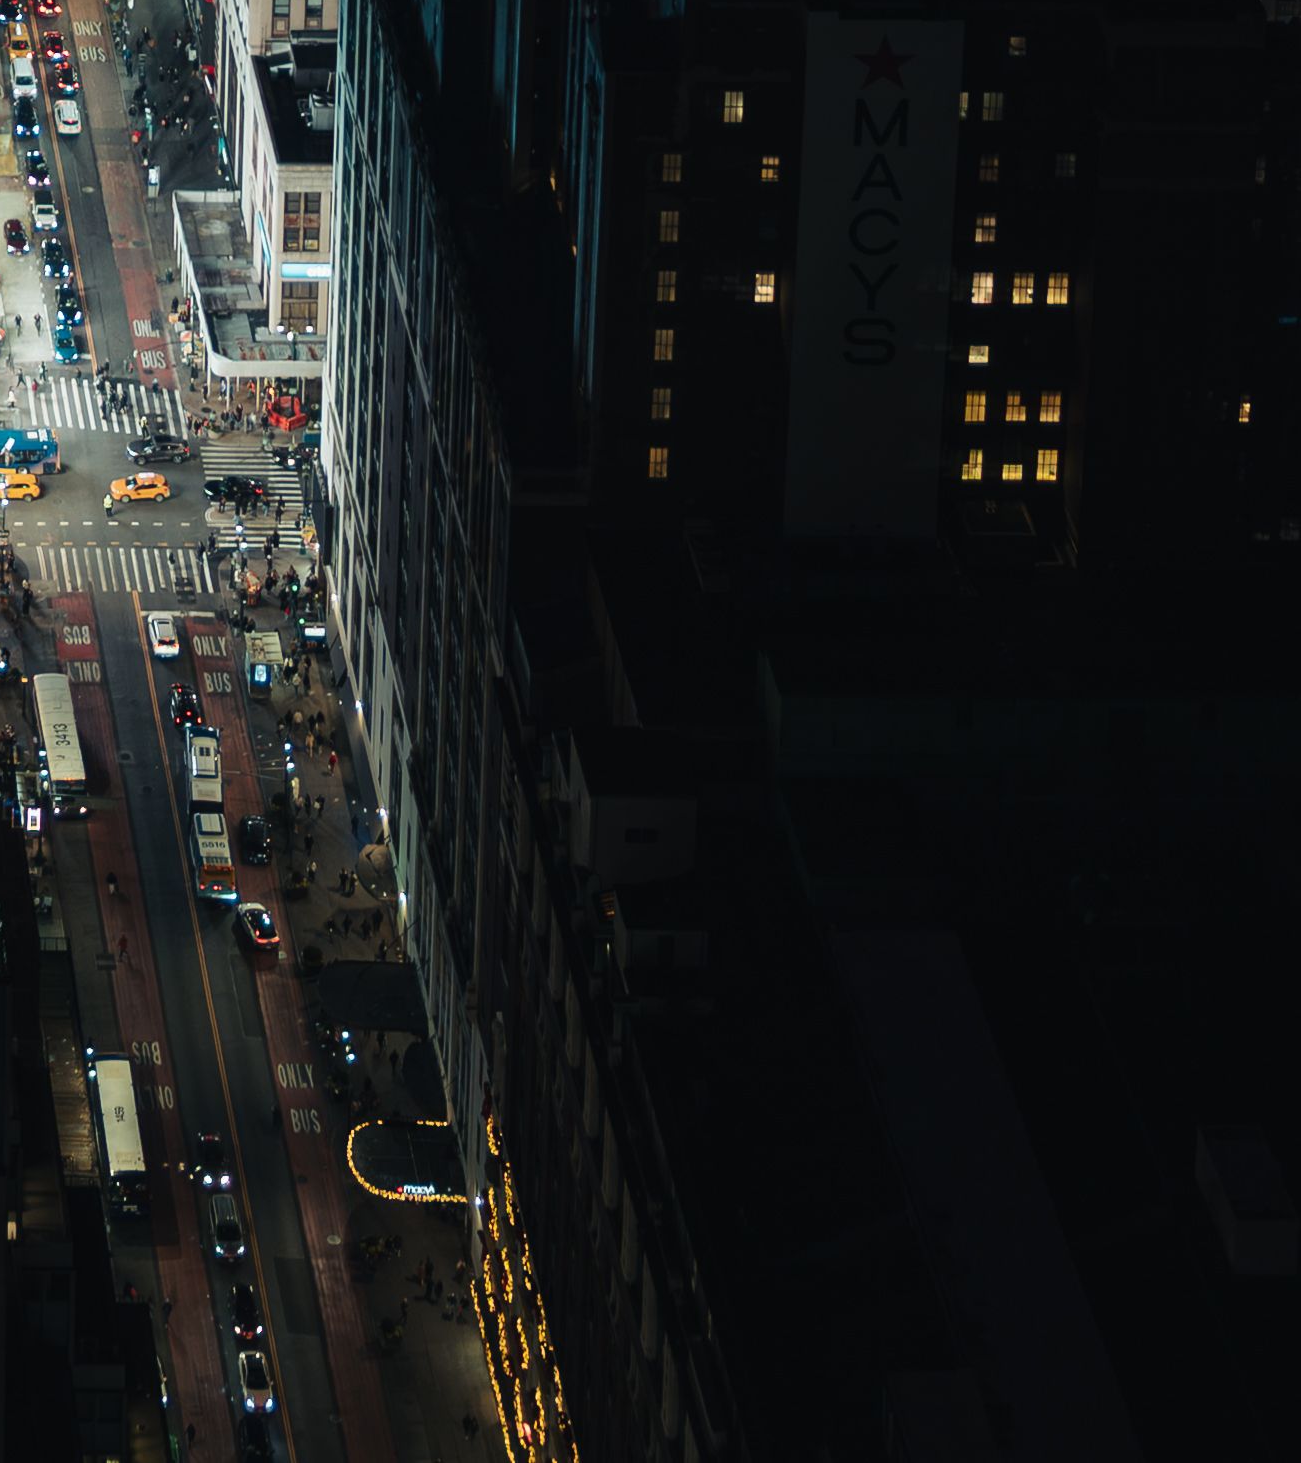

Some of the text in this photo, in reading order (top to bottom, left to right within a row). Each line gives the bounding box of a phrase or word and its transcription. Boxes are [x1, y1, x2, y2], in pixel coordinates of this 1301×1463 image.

[73, 20, 102, 36] ONLY
[79, 46, 106, 63] BUS
[841, 97, 910, 366] MACYS
[140, 350, 167, 370] BUS
[63, 625, 92, 646] BUS
[193, 635, 227, 657] ONLY
[203, 672, 232, 693] BUS
[53, 723, 71, 746] 3413
[131, 1041, 162, 1066] BUS
[277, 1063, 315, 1089] ONLY
[290, 1108, 322, 1135] BUS
